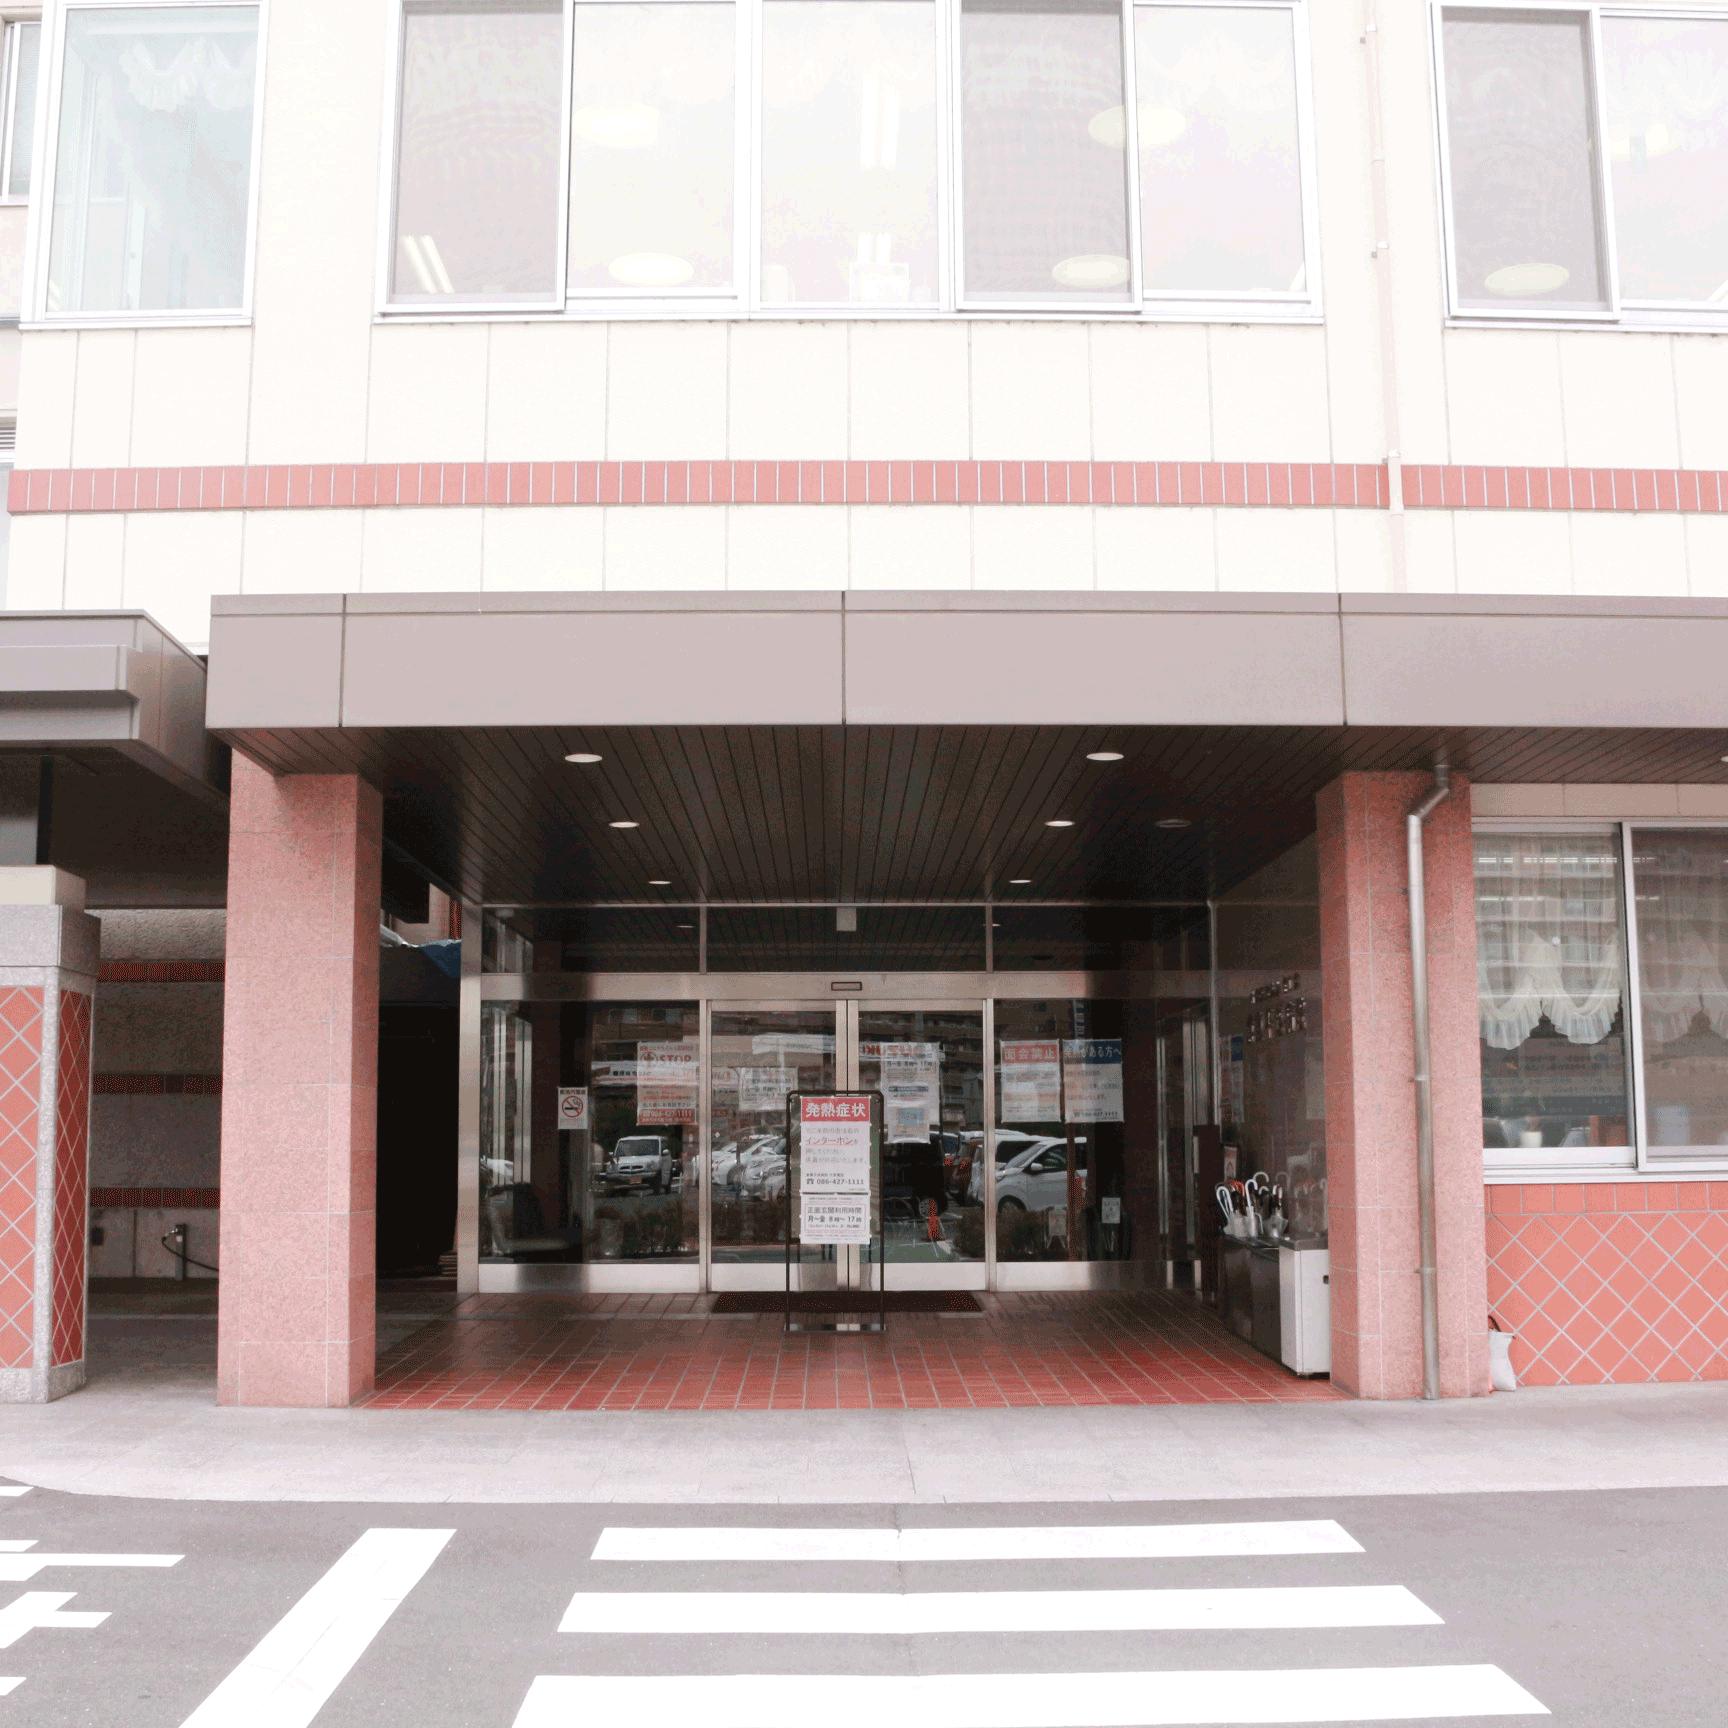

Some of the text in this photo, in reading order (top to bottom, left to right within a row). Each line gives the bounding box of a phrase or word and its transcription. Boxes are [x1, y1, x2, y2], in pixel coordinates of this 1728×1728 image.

[659, 1054, 692, 1063] STOP
[1004, 1048, 1057, 1060] 面会禁止
[805, 1102, 866, 1118] 発熱症状
[806, 1136, 858, 1145] インターホンを
[807, 1206, 862, 1214] 正面玄関利用時間
